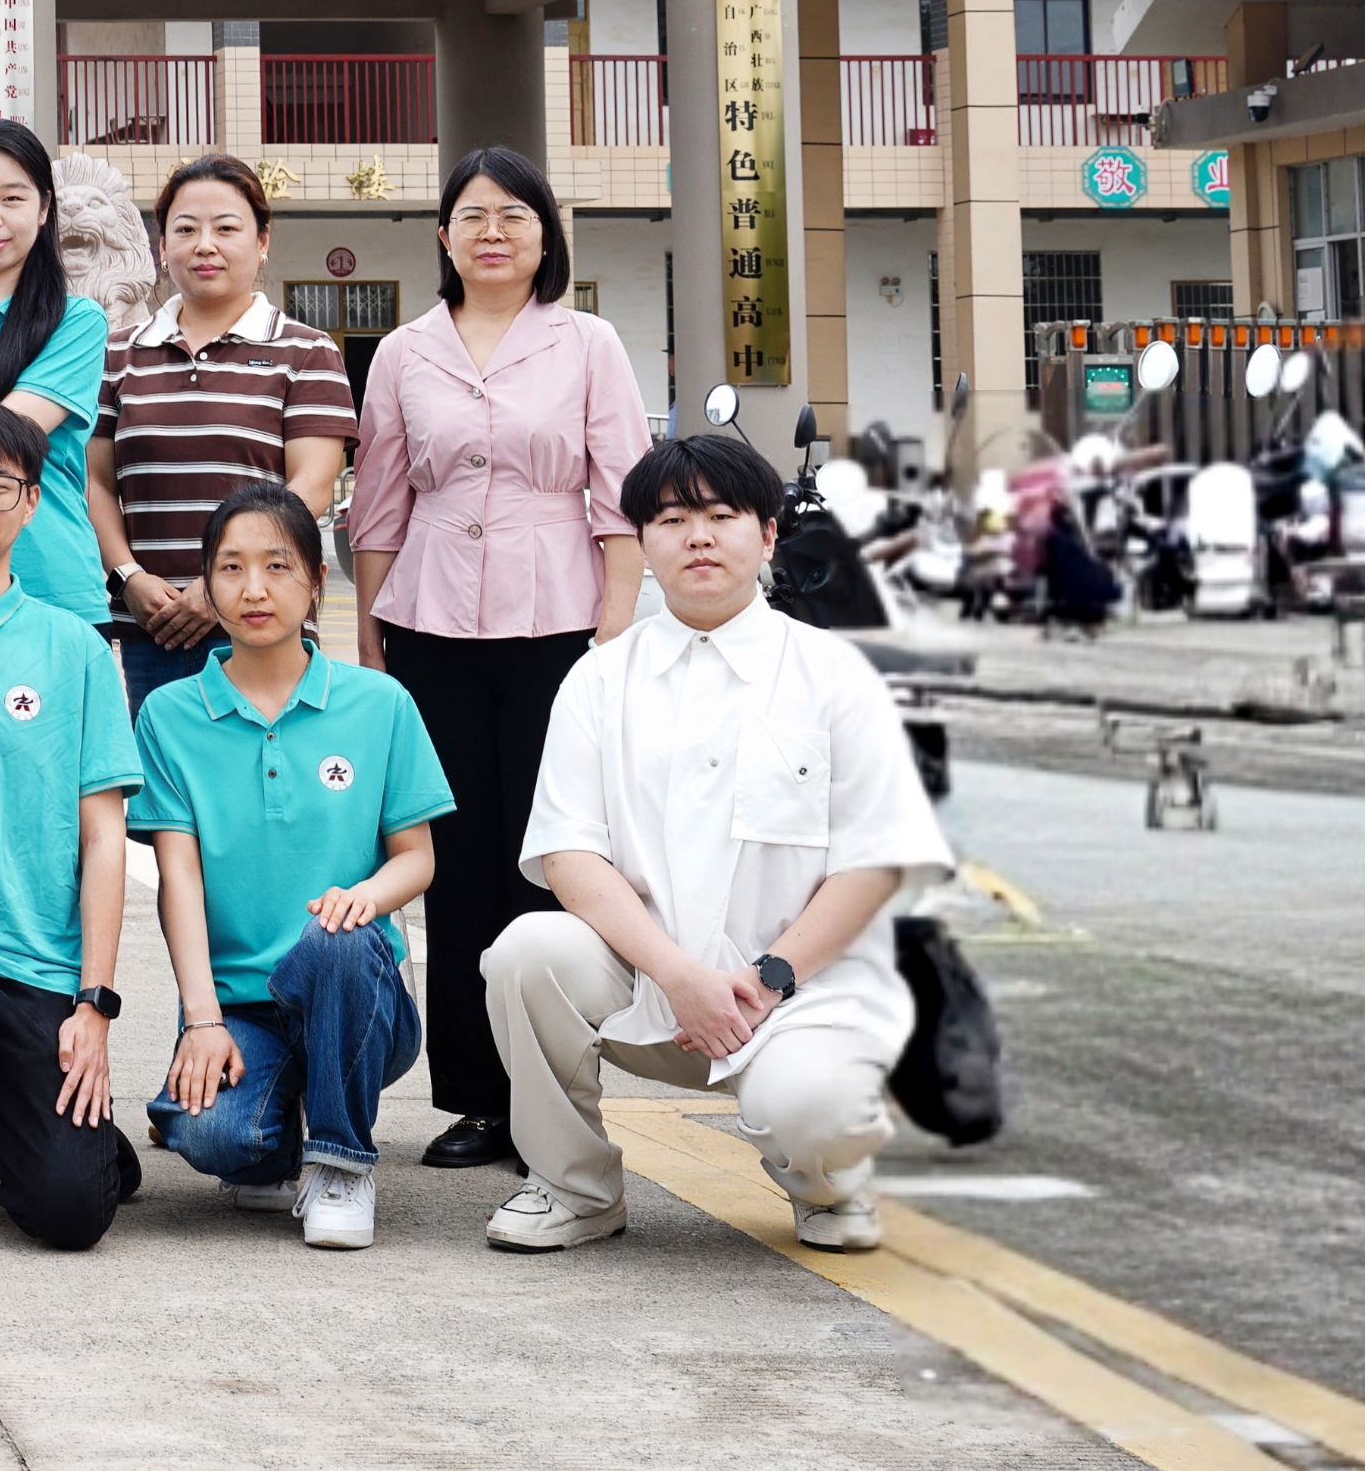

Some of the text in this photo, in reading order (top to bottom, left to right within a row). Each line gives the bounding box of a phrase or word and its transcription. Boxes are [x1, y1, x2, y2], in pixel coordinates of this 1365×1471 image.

[724, 4, 738, 93] 自治区
[750, 4, 764, 92] 广西壮族
[725, 100, 763, 377] 特色普通高中
